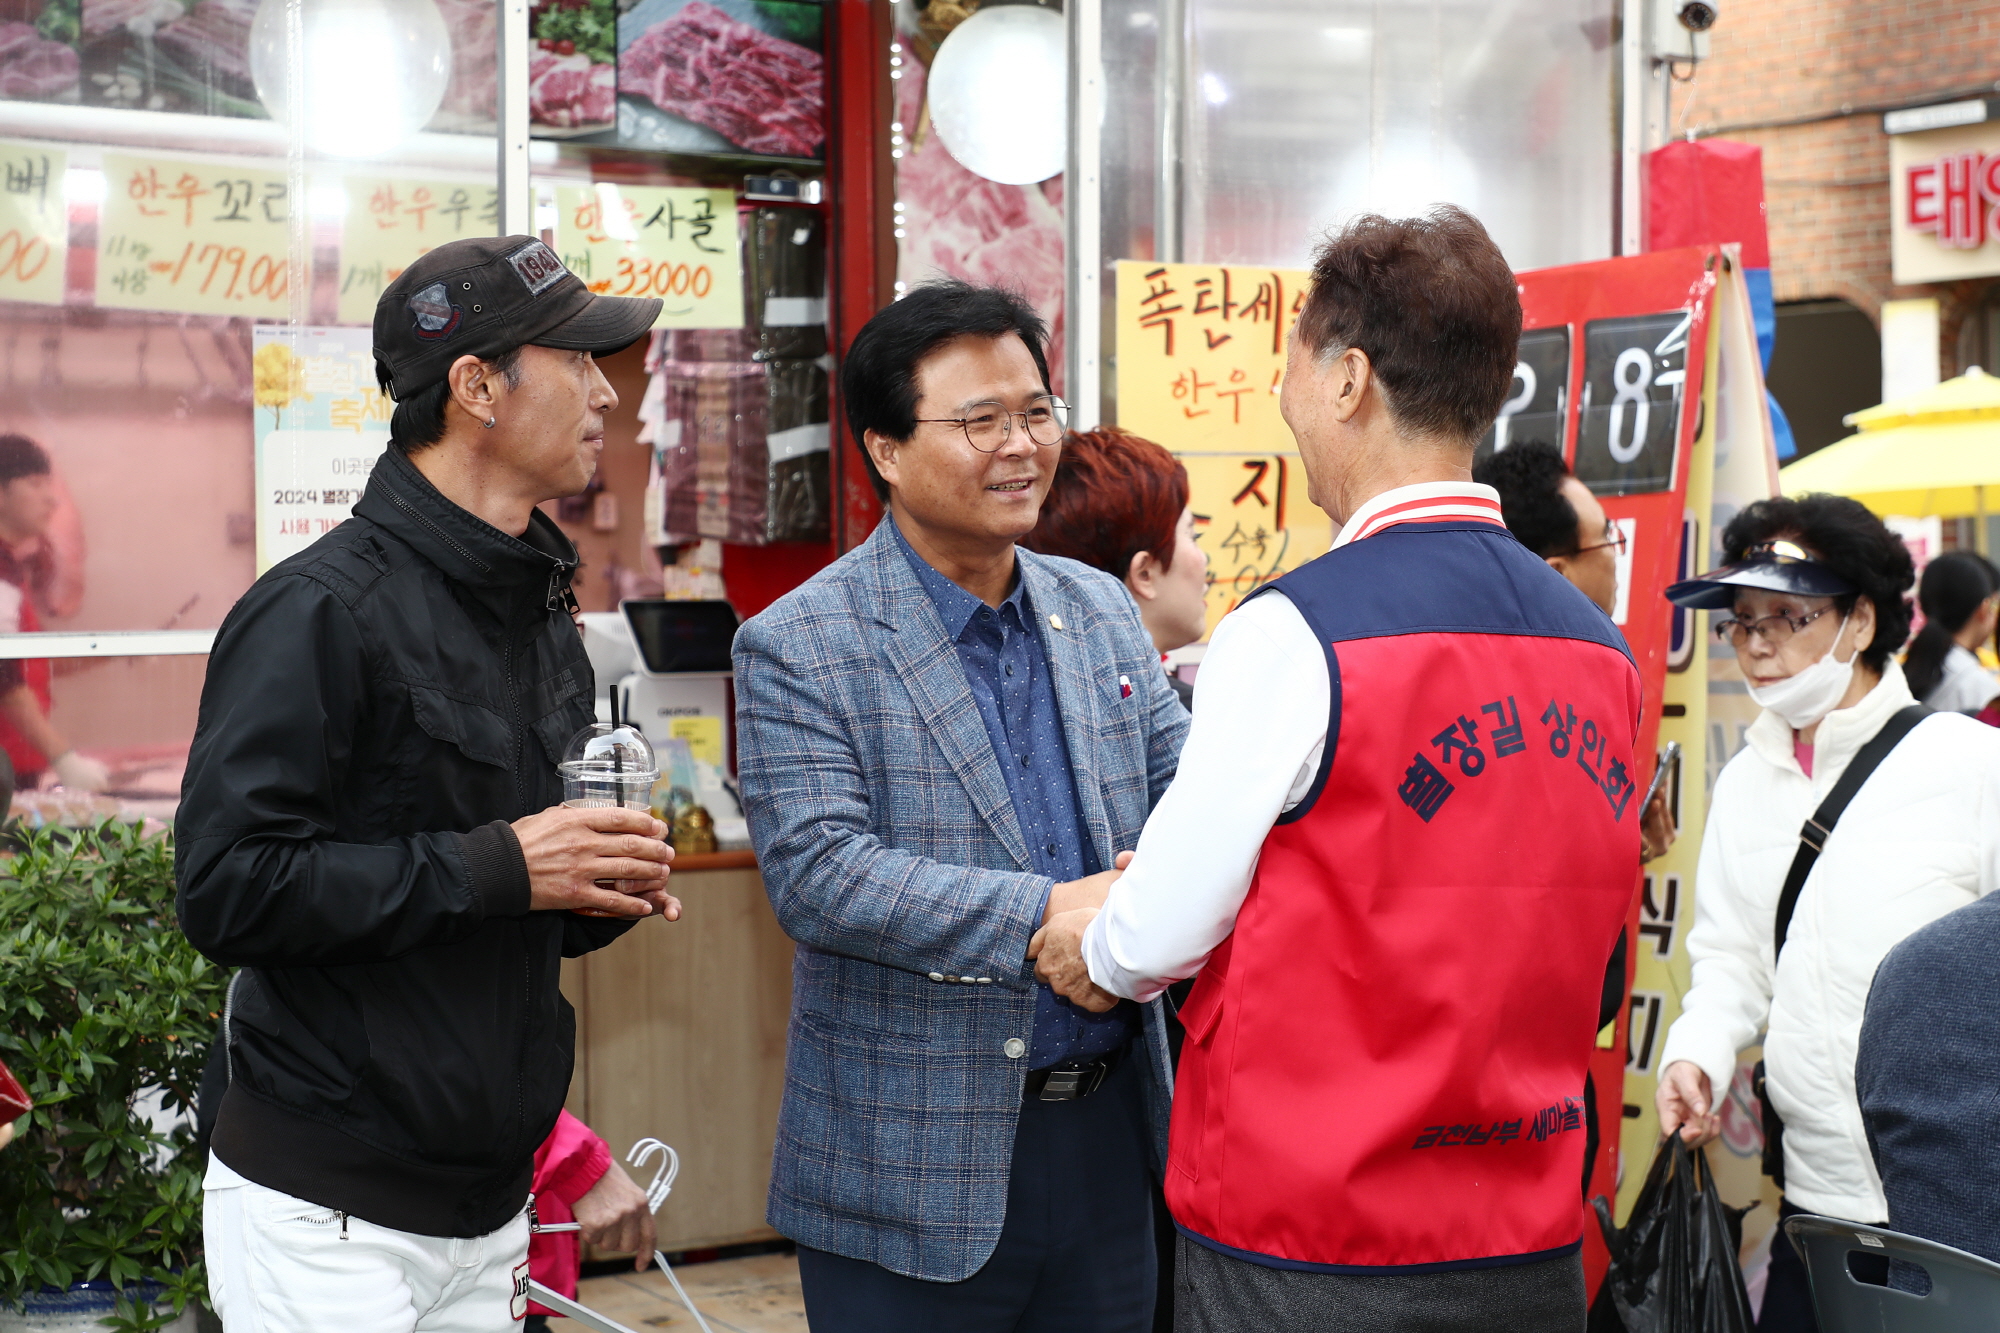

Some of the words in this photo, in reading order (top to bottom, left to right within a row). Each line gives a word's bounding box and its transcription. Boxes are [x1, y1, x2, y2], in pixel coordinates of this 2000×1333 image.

[128, 167, 211, 227] 한우
[369, 181, 438, 232] 한우
[643, 197, 725, 253] 사골
[1170, 367, 1255, 424] 한우
[273, 490, 317, 505] 2024
[280, 518, 310, 535] 사용
[1397, 695, 1527, 824] 별장길
[1539, 698, 1636, 824] 상인회
[1411, 1118, 1523, 1149] 금천남부
